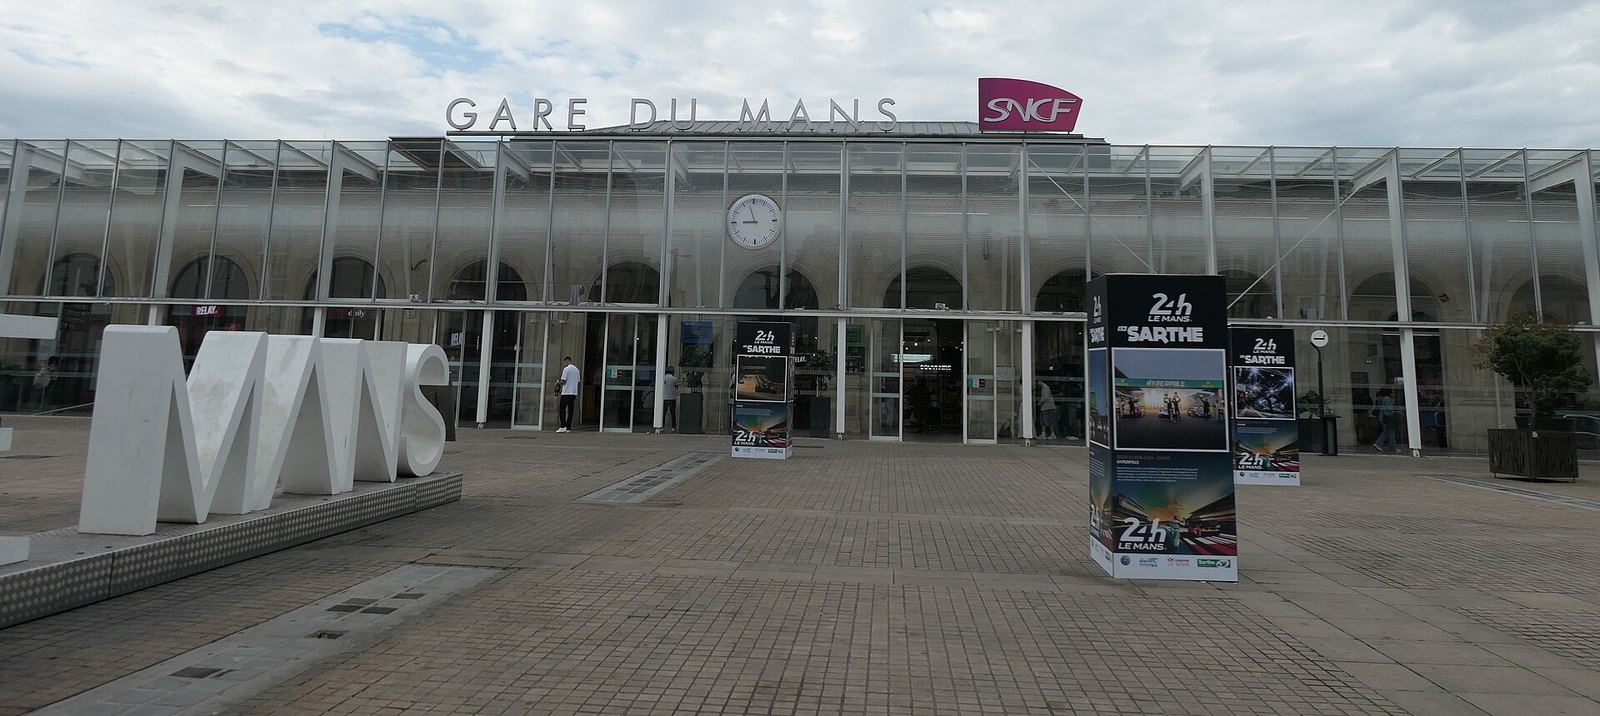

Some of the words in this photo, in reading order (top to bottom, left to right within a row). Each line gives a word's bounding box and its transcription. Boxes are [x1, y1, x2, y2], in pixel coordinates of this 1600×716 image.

[445, 97, 587, 130] GARE
[630, 97, 697, 131] DU
[737, 97, 897, 132] MANS
[983, 97, 1077, 123] SNCF
[1149, 293, 1192, 315] 24h
[1127, 326, 1203, 344] SARTHE
[1253, 338, 1277, 350] 24h
[747, 345, 781, 354] SARTHE
[1245, 355, 1285, 365] SARTHE
[78, 324, 449, 536] MANS
[1120, 517, 1167, 542] 24h
